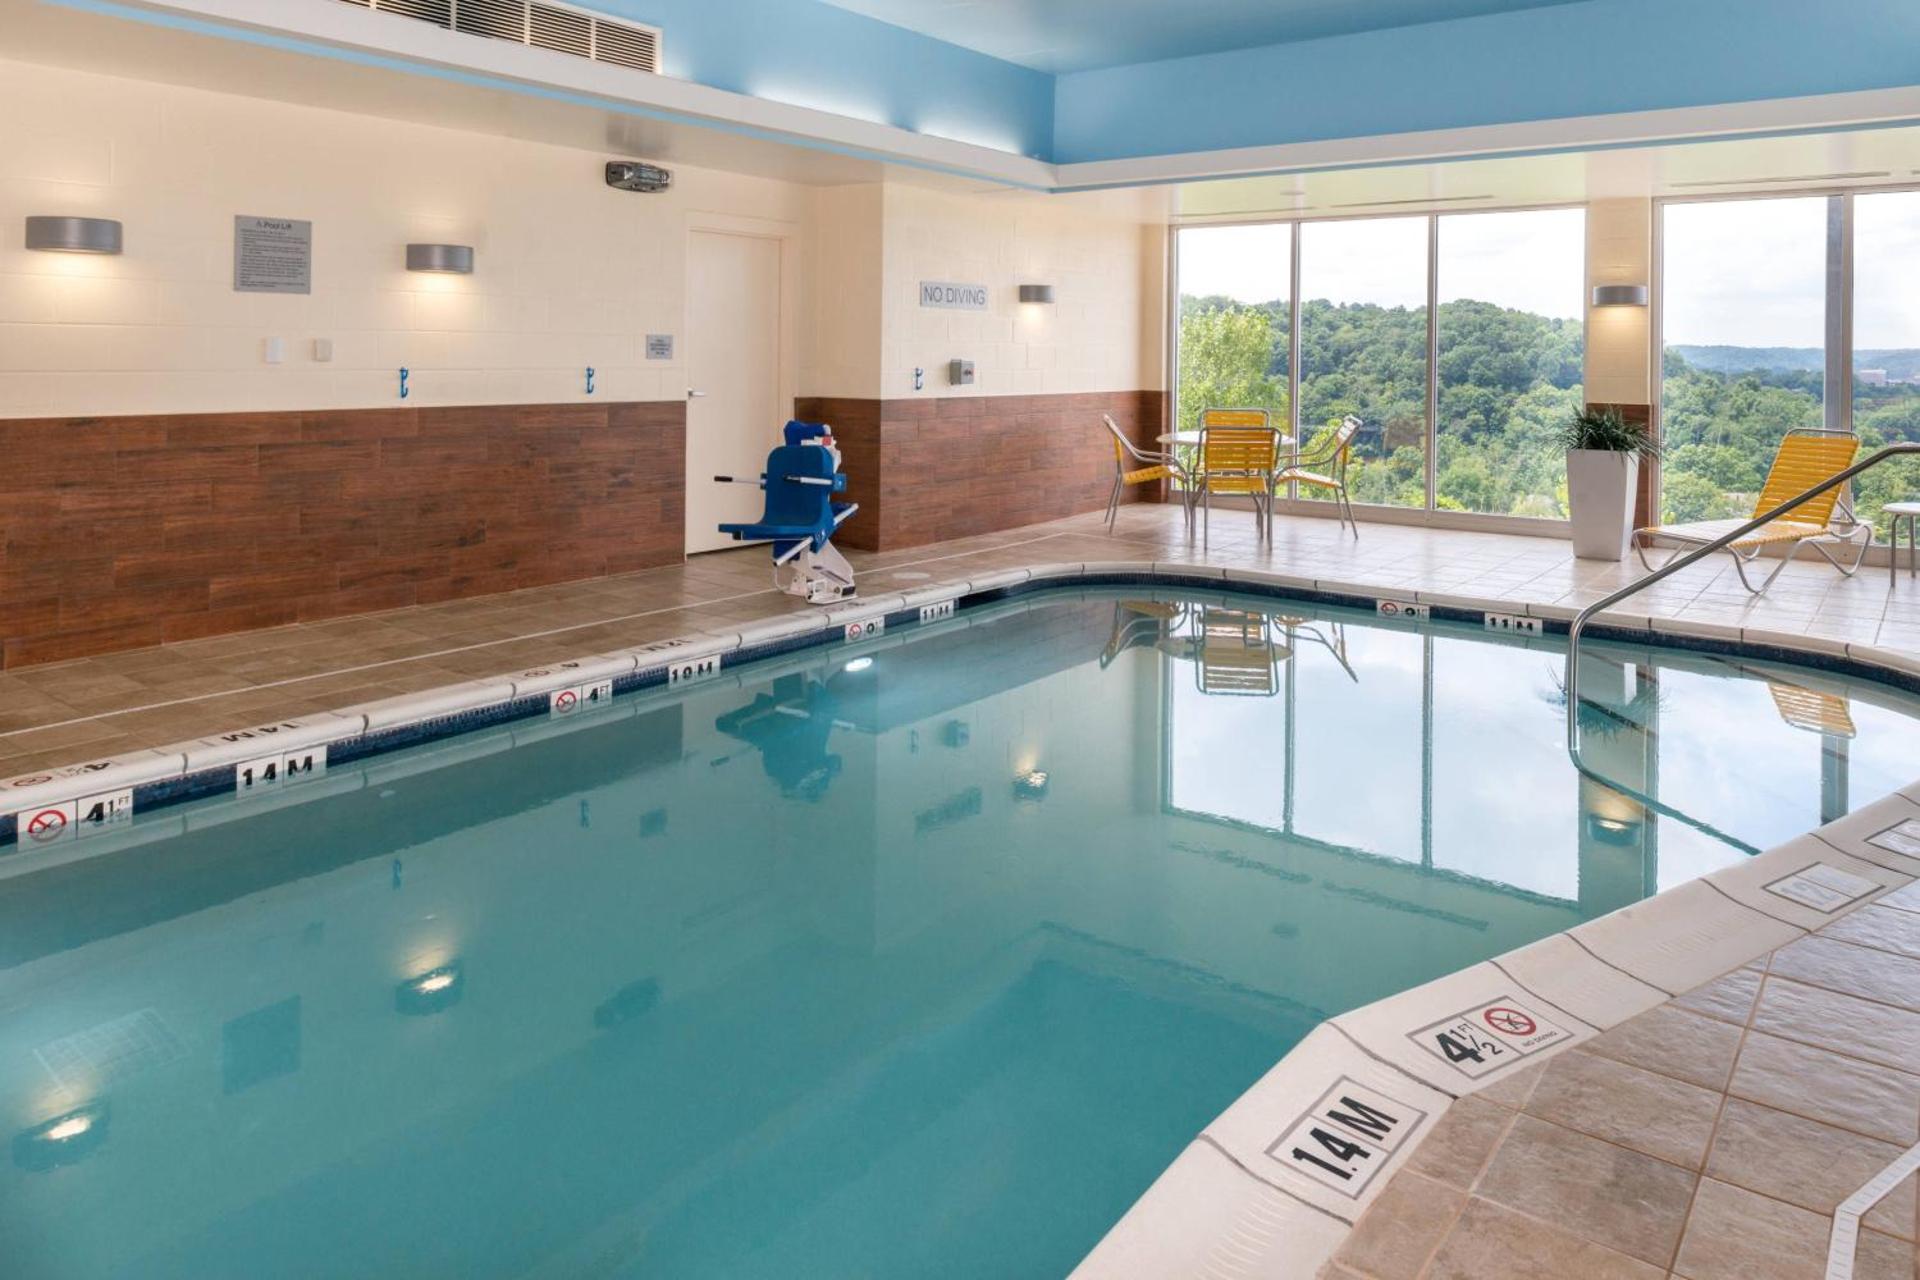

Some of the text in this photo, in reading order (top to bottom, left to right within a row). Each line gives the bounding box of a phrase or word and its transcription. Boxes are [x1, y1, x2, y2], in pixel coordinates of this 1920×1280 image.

[924, 286, 986, 305] NO DIVING
[1326, 1096, 1399, 1142] M
